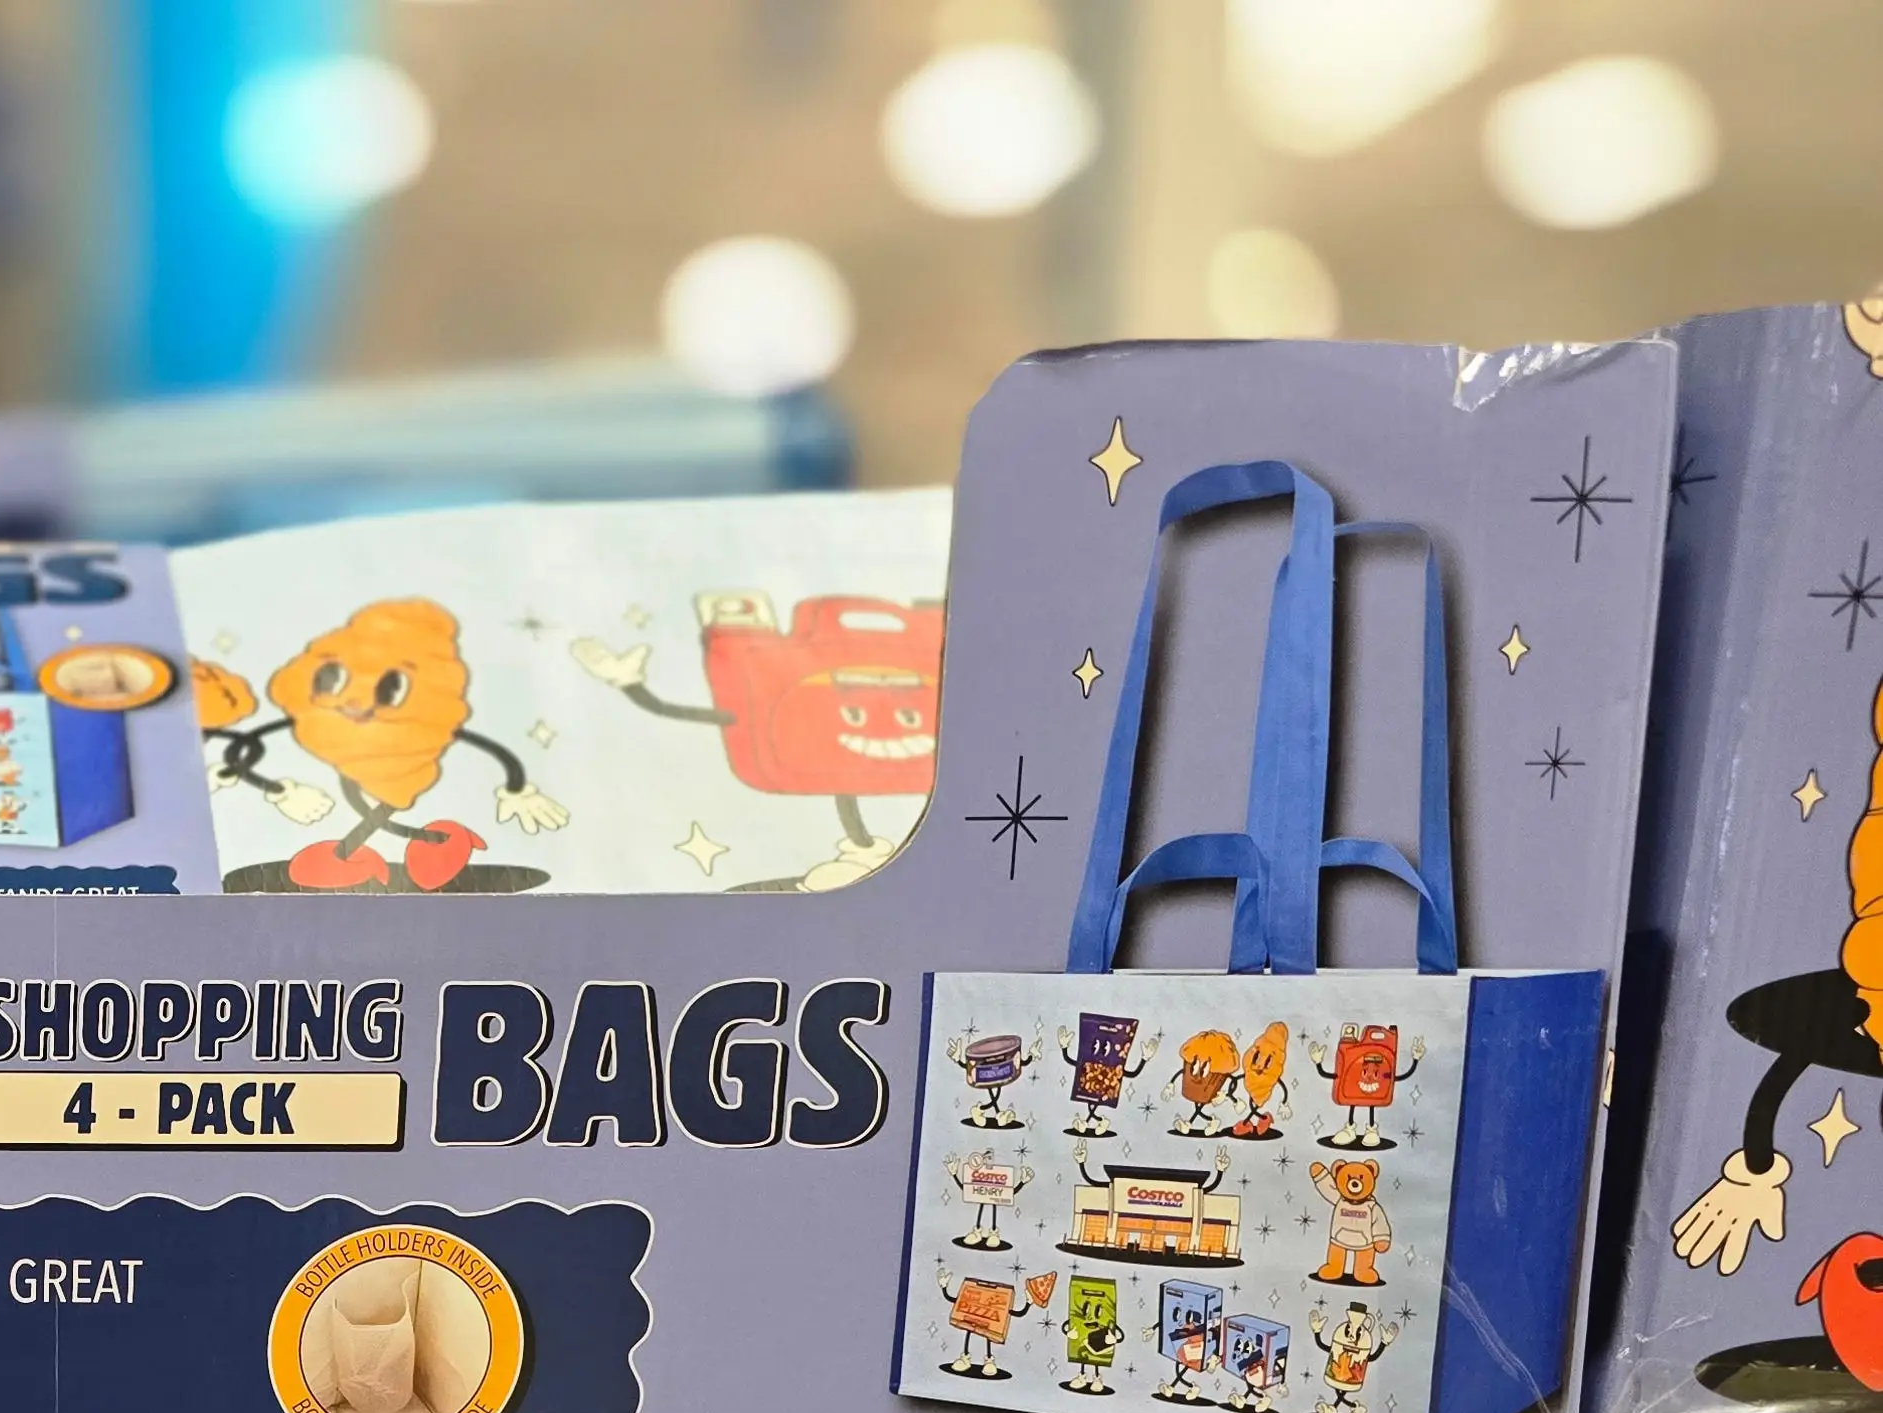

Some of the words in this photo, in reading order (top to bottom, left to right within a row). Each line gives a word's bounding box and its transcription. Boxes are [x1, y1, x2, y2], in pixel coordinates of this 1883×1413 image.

[431, 976, 891, 1149] BAGS
[62, 1082, 97, 1134] 4
[118, 1108, 136, 1120] -
[156, 1081, 297, 1137] PACK
[972, 1186, 1004, 1197] HENRY
[1127, 1186, 1185, 1203] COSTCO
[8, 1257, 144, 1306] GREAT
[295, 1243, 356, 1298] BOTTLE
[356, 1231, 449, 1258] HOLDERS
[447, 1245, 503, 1301] INSIDE
[958, 1300, 1001, 1323] PIZZA
